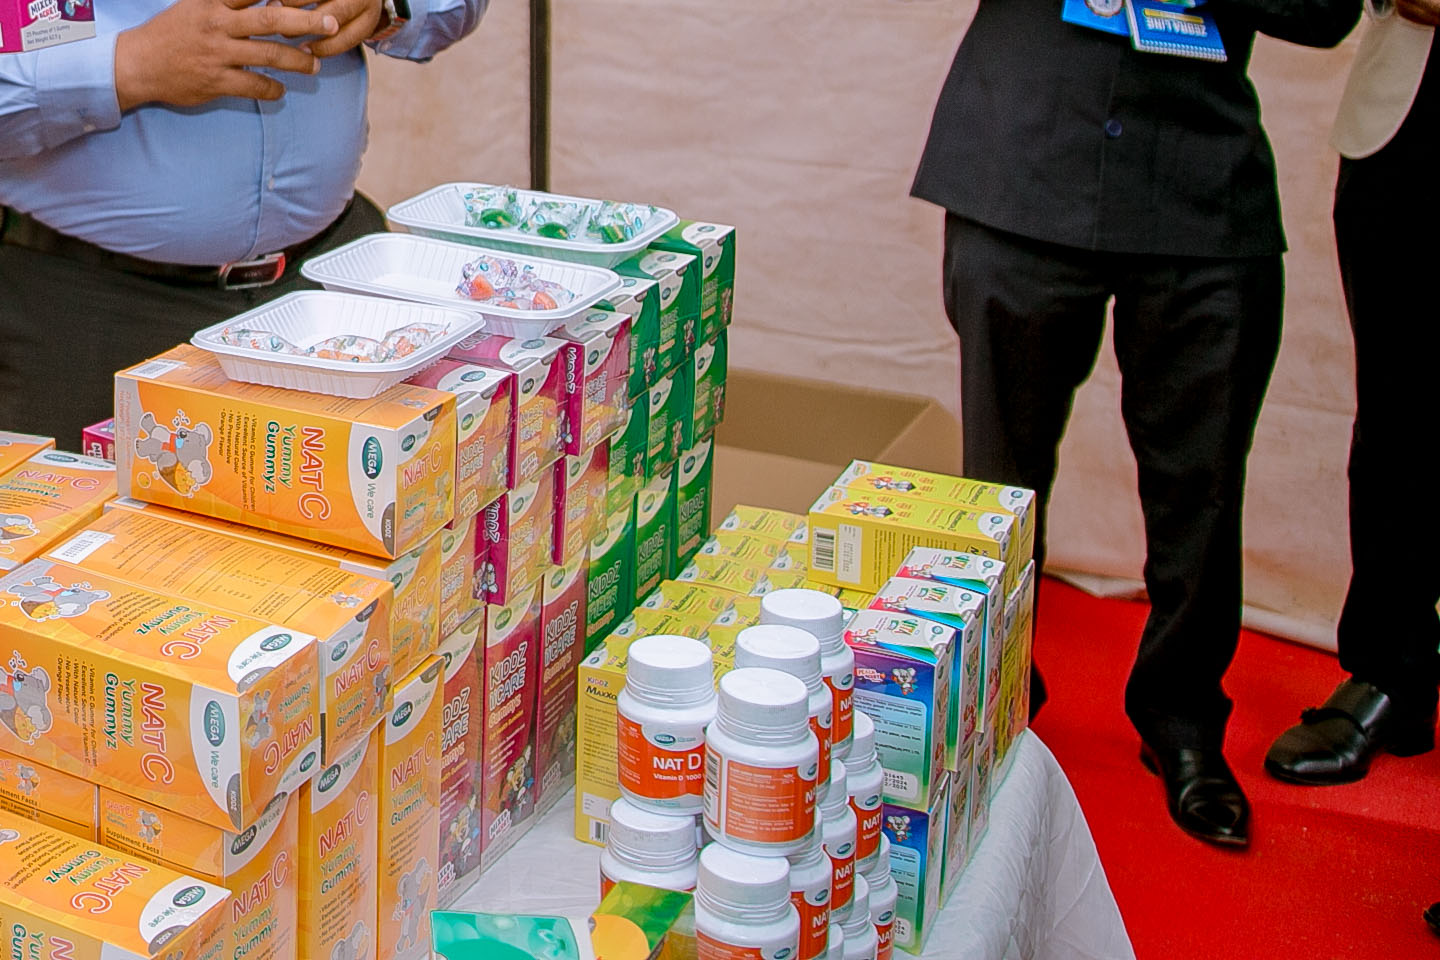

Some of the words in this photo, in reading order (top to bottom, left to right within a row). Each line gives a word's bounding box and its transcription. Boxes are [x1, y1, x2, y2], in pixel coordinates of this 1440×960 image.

[30, 0, 52, 16] MIXED
[1173, 19, 1208, 37] ZEBRA
[228, 414, 234, 422] No
[250, 418, 258, 444] Vitamin
[248, 451, 256, 474] Gummy
[262, 420, 280, 494] Gummyz
[279, 424, 297, 488] Yummy
[300, 426, 326, 491] NAT
[368, 440, 377, 474] MEGA
[402, 453, 430, 489] NAT
[431, 442, 442, 472] C
[16, 470, 69, 485] NAT
[70, 478, 100, 490] C
[242, 471, 248, 479] of
[368, 483, 376, 498] We
[298, 492, 331, 520] C
[367, 499, 376, 519] care
[678, 488, 706, 522] KIDDZ
[637, 524, 666, 564] KIDDZ
[416, 576, 427, 607] C
[588, 560, 622, 602] KIDDZ
[587, 585, 618, 624] FIBER
[135, 605, 190, 636] Gummyz
[184, 615, 238, 646] NAT
[544, 600, 578, 646] KIDDZ
[160, 641, 202, 660] C
[262, 634, 290, 651] MEGA
[56, 657, 64, 681] Orange
[66, 660, 72, 668] No
[335, 655, 366, 698] NAT
[367, 639, 380, 671] C
[489, 640, 528, 690] KIDDZ
[588, 676, 608, 688] KIDDZ
[102, 672, 119, 751] Gummyz
[120, 679, 136, 748] Yummy
[140, 682, 166, 752] NAT
[210, 706, 220, 742] MEGA
[394, 706, 412, 724] MEGA
[82, 722, 88, 731] of
[282, 714, 313, 759] NAT
[141, 752, 174, 784] C
[210, 750, 220, 768] We
[264, 741, 281, 776] C
[390, 746, 424, 792] NAT
[423, 730, 436, 766] C
[652, 756, 684, 772] NAT
[688, 752, 702, 770] D
[212, 768, 220, 788] care
[319, 769, 340, 790] MEGA
[653, 772, 678, 781] Vitamin
[686, 773, 702, 781] 1000
[21, 794, 38, 806] Facts
[319, 808, 354, 860] NAT
[354, 790, 369, 826] C
[490, 810, 510, 836] MIXED
[863, 813, 881, 832] NAT
[106, 828, 141, 848] Supplement
[142, 842, 160, 854] Facts
[234, 828, 256, 852] MEGA
[44, 850, 102, 884] Gummyz
[69, 856, 120, 885] Yummy
[320, 840, 358, 876] Yummy
[835, 862, 854, 881] NAT
[93, 862, 150, 896] NAT
[232, 870, 272, 924] NAT
[272, 850, 288, 890] C
[70, 891, 112, 914] C
[175, 886, 204, 906] MEGA
[148, 914, 164, 928] care
[233, 902, 274, 942] Yummy
